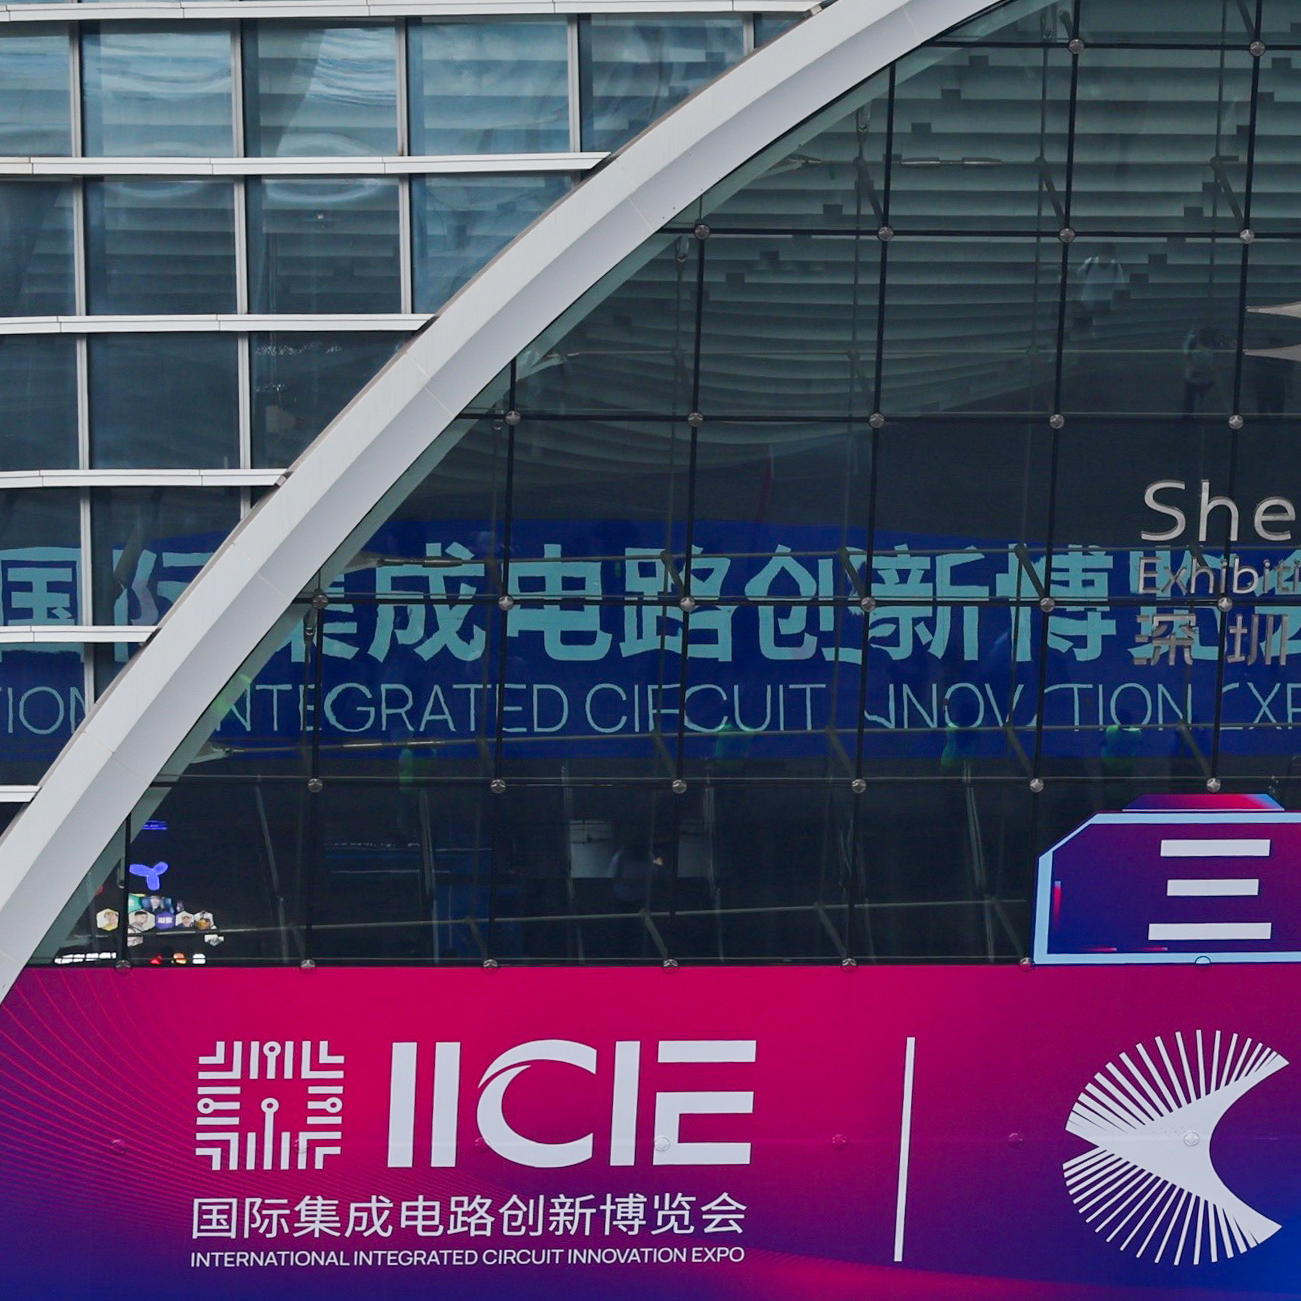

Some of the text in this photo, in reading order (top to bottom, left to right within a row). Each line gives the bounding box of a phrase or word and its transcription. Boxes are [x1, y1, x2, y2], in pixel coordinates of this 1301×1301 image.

[387, 1039, 757, 1168] IICIE
[190, 1192, 748, 1241] 国际集成电路创新博览会
[190, 1246, 745, 1268] INTERNATIONAL INTEGRATED CIRCUIT INNOVATION EXPO
